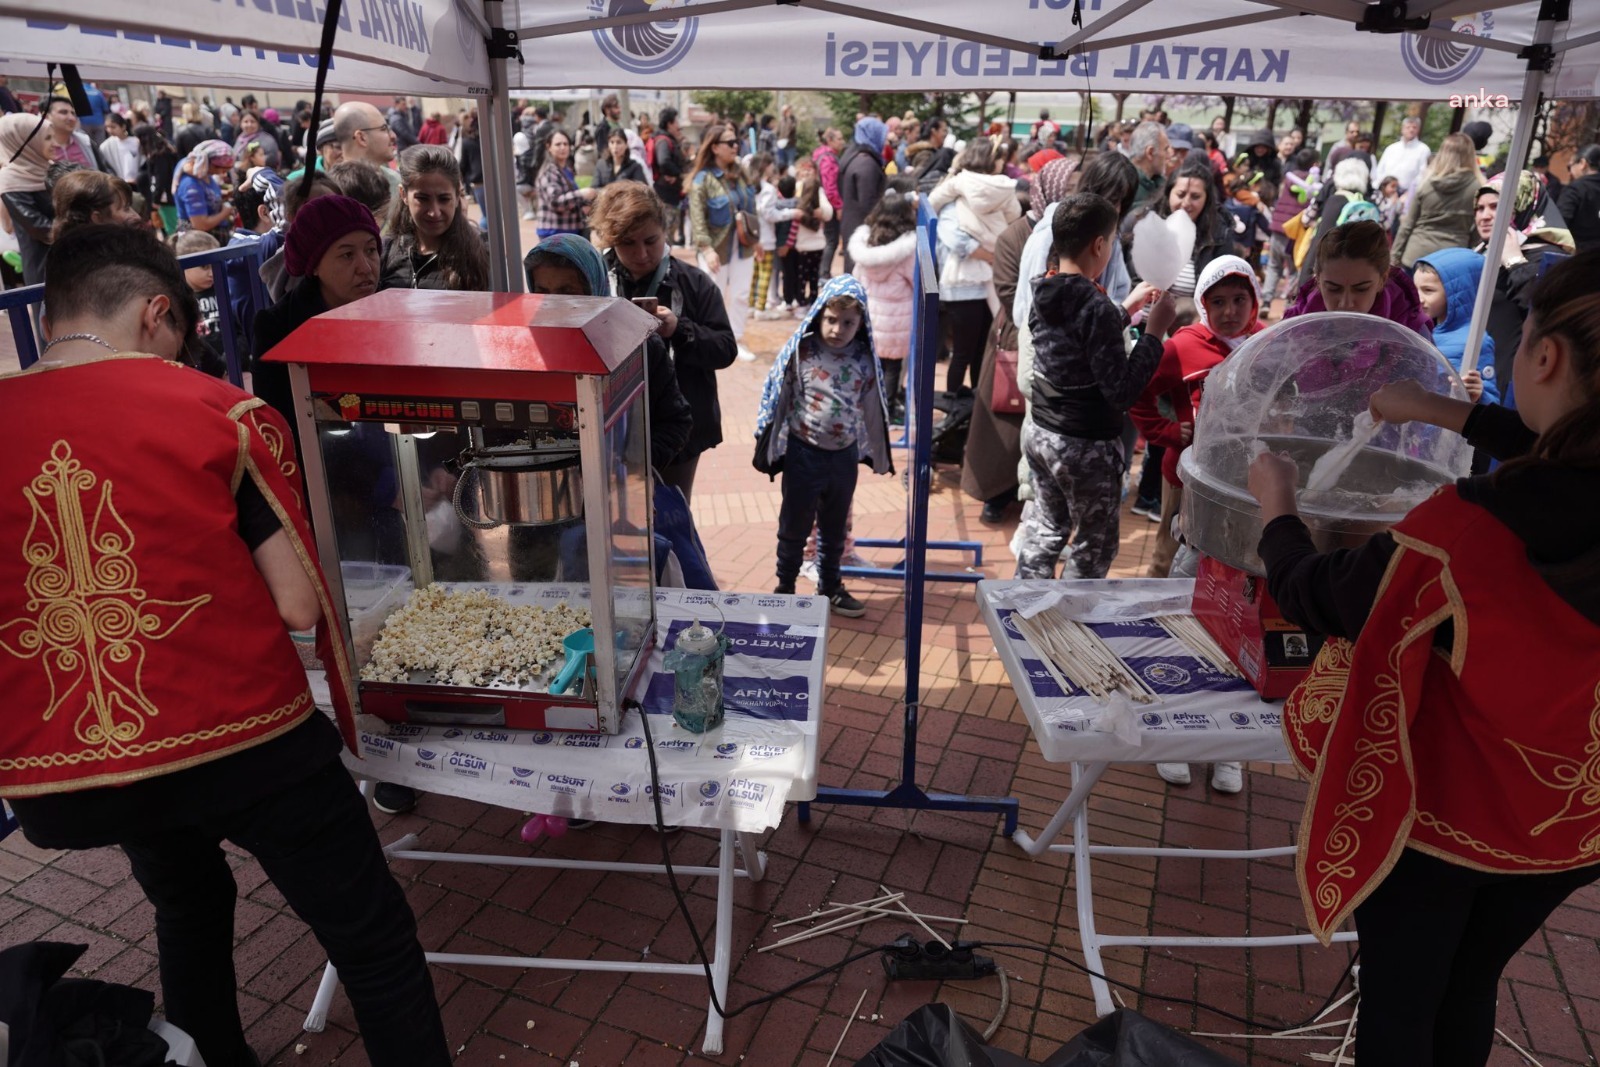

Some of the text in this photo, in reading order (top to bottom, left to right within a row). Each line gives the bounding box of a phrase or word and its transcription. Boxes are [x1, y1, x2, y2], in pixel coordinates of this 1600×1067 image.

[364, 400, 455, 418] POPCORN
[750, 640, 807, 650] AFİYET
[361, 735, 394, 750] OLSUN
[450, 757, 487, 770] OLSUN
[645, 785, 675, 797] OSUN
[730, 779, 767, 792] AFİYET
[728, 788, 764, 802] OLSUN
